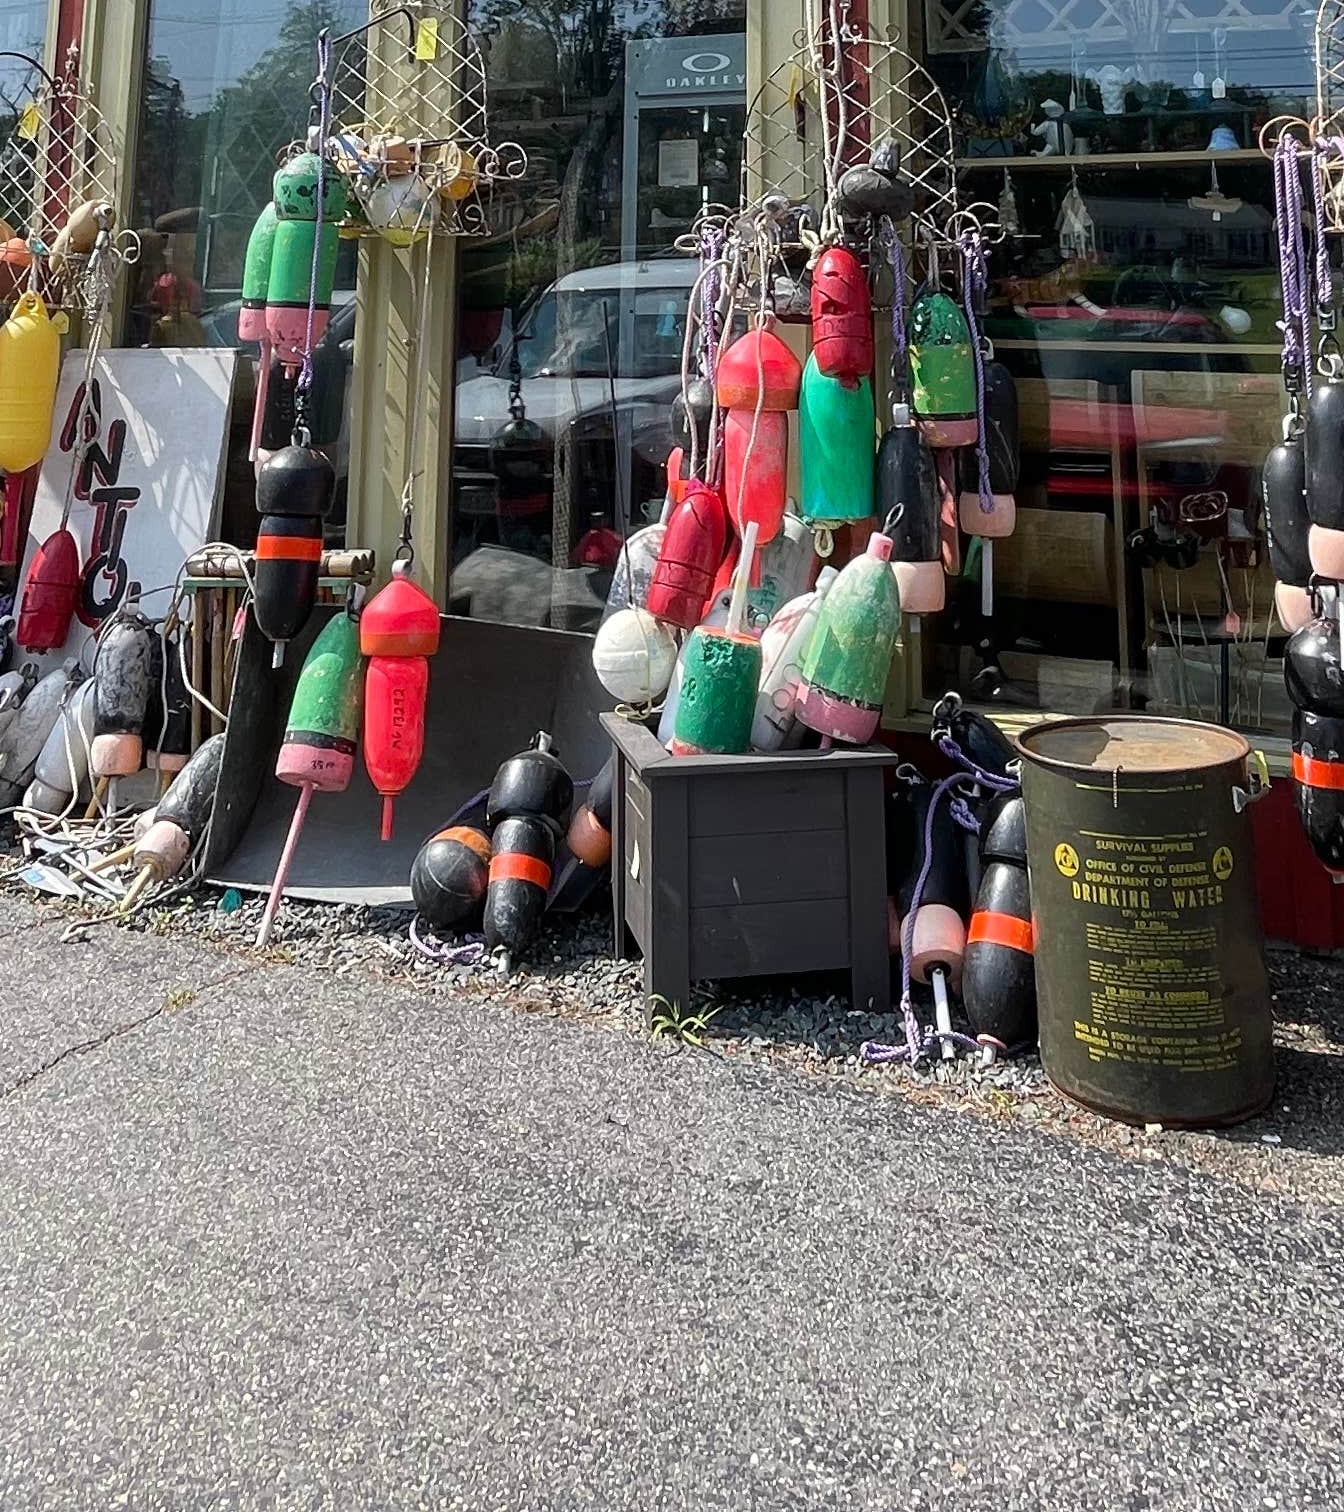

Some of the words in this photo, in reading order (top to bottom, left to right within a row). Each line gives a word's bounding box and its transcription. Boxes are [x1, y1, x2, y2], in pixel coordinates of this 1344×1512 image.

[666, 73, 746, 87] OAKLEY
[1095, 840, 1146, 853] SURVIVAL
[1151, 842, 1194, 853] SUPPLIES
[1085, 859, 1118, 873] OFFICE
[1121, 863, 1135, 874] OF
[1139, 862, 1165, 874] CIVIL
[1169, 861, 1207, 874] DEFENSE
[1085, 871, 1149, 887] DEPARTMENT
[1153, 877, 1168, 888] OF
[1171, 874, 1210, 887] DEFENSE
[1072, 881, 1150, 909] DRINKING
[1172, 885, 1224, 909] WATER
